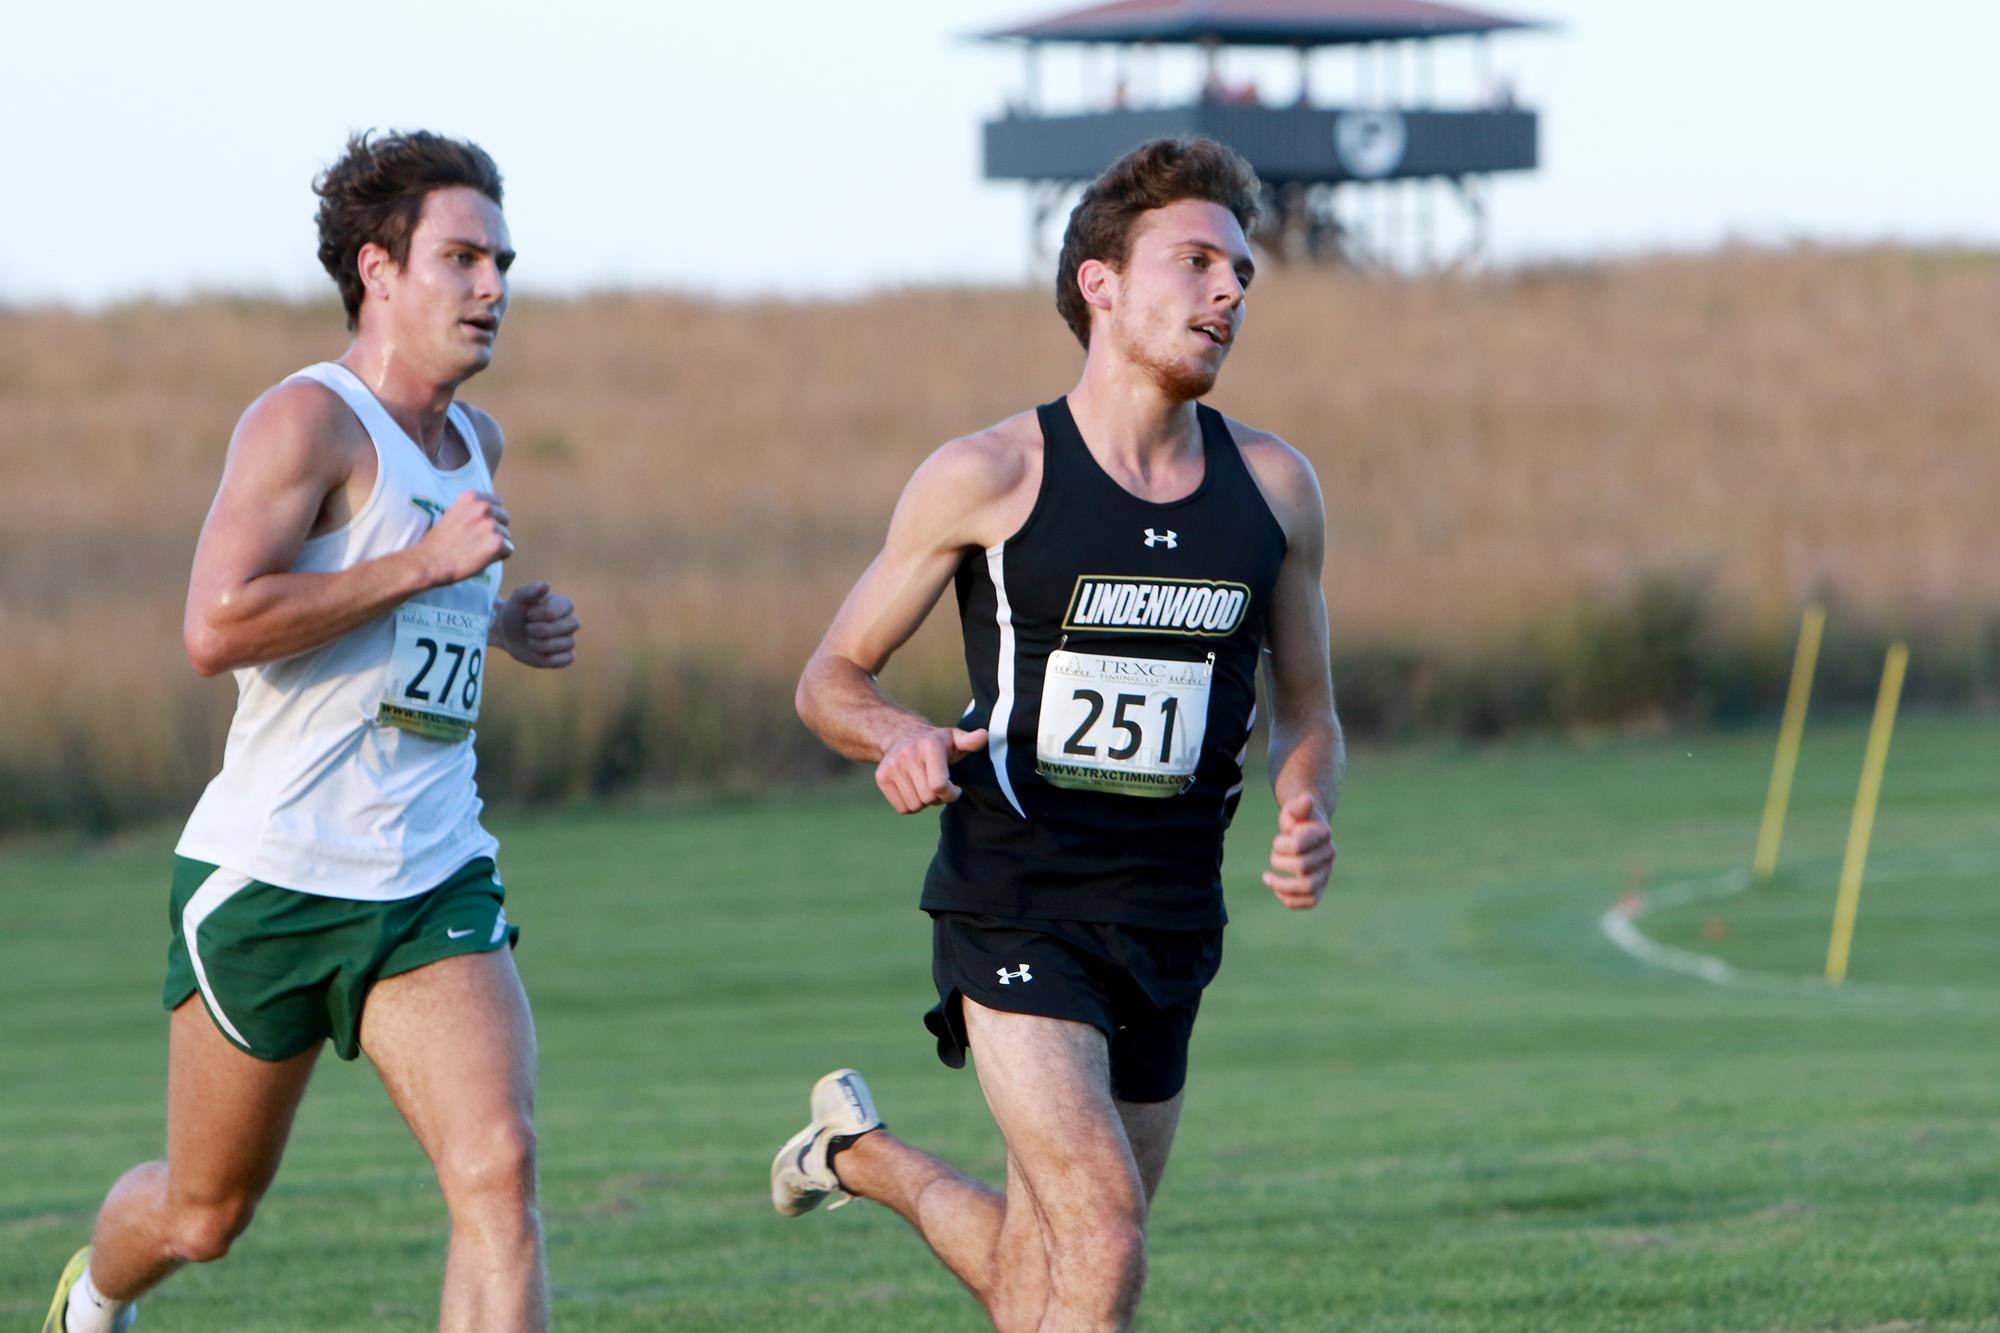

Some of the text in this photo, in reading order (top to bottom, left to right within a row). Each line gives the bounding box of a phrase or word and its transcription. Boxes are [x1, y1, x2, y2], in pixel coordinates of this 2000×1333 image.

[1073, 583, 1245, 631] LINDENWOOD
[404, 637, 482, 710] 278
[1095, 658, 1167, 678] TRXC
[1063, 689, 1179, 764] 251
